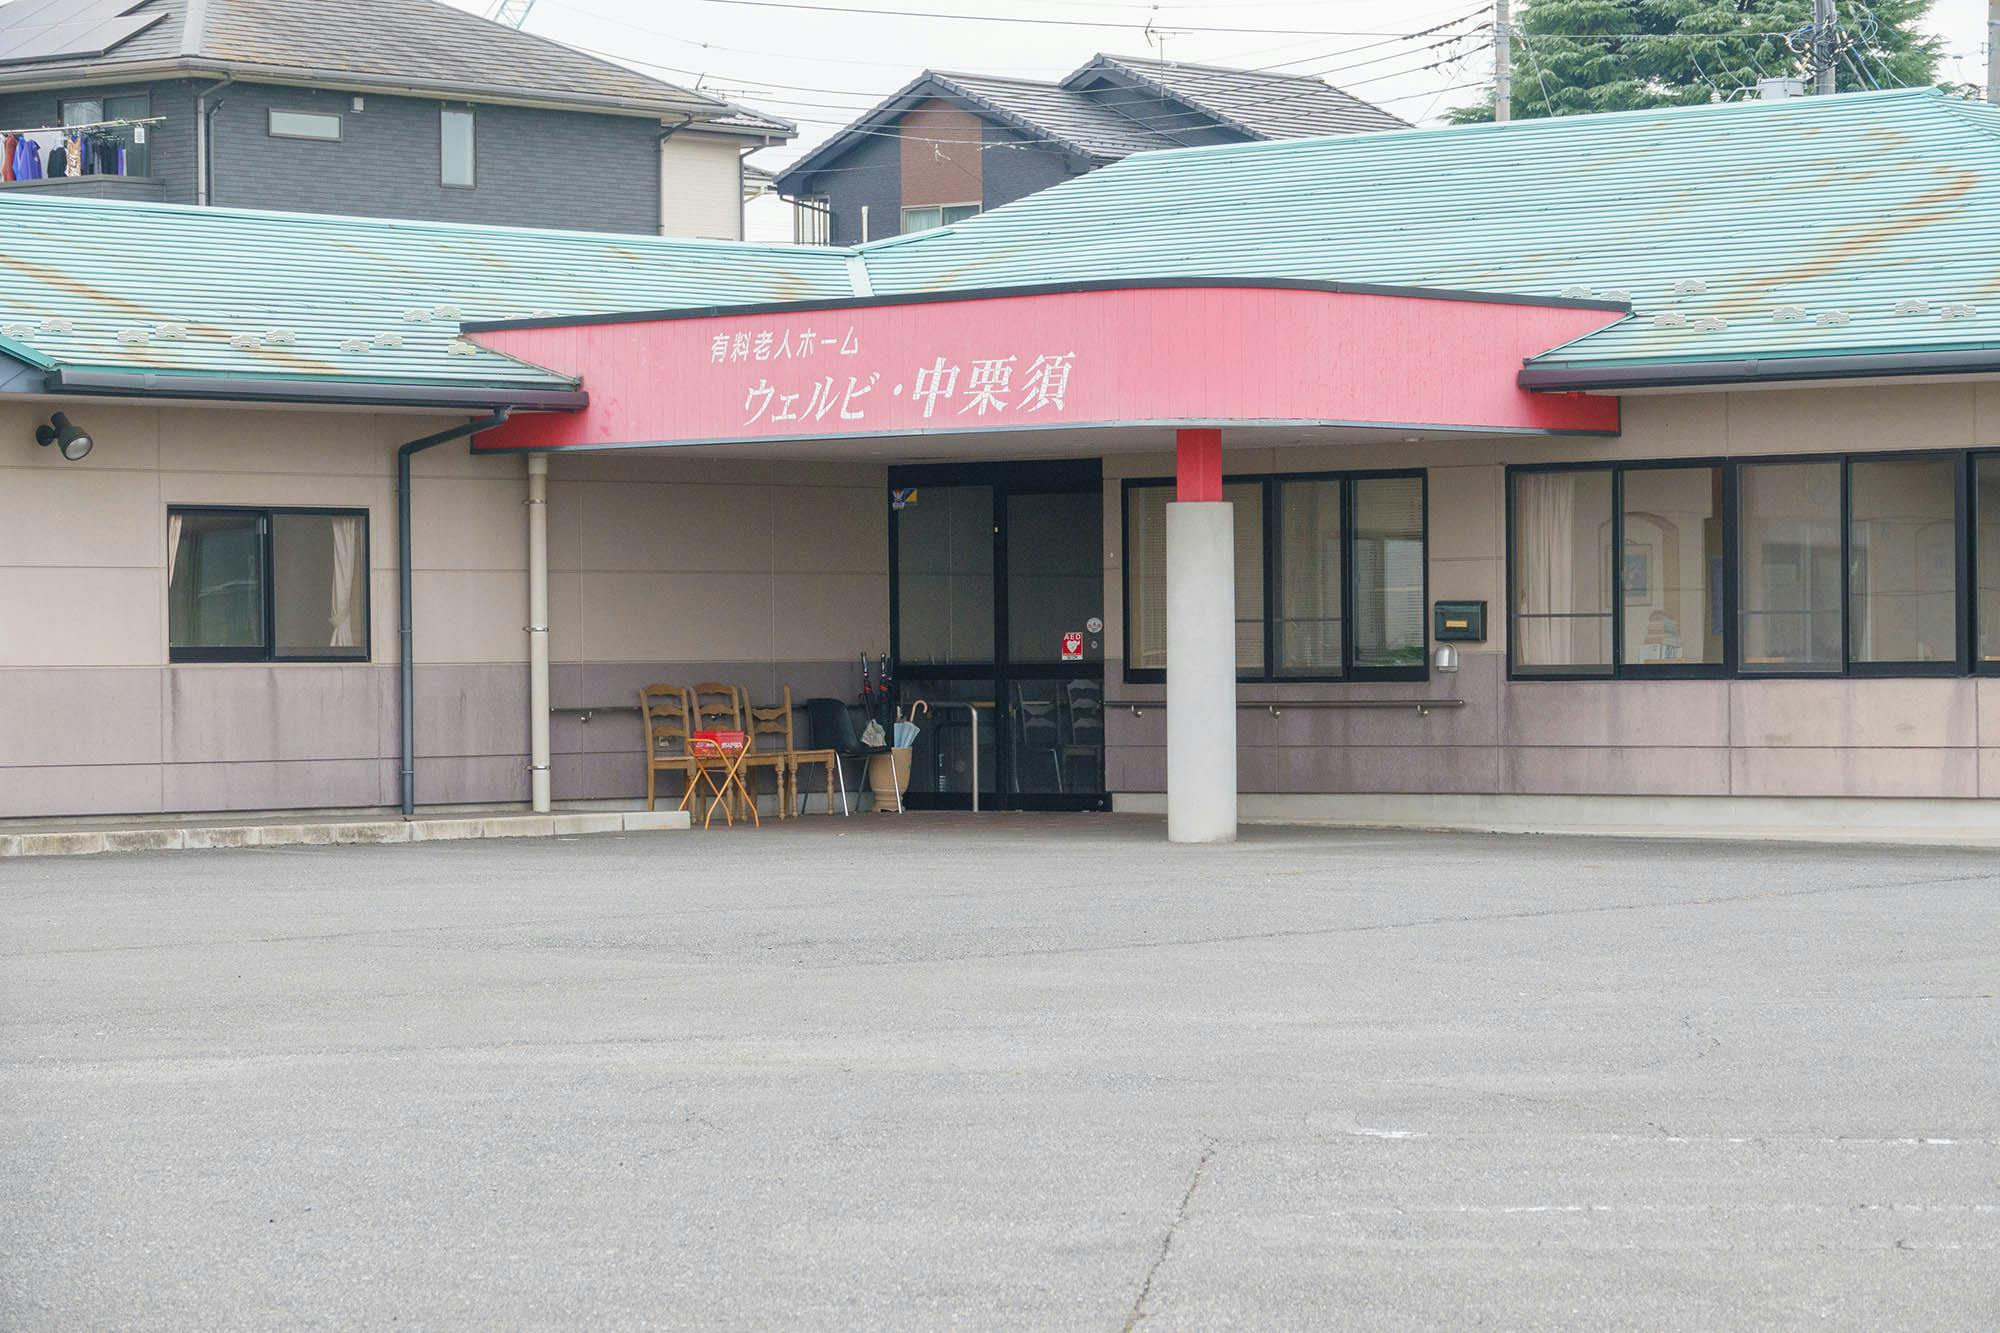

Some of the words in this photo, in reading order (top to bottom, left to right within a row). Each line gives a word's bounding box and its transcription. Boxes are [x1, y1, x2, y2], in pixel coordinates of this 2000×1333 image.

[711, 326, 859, 363] 有料老人ホーム
[743, 351, 1076, 426] ウェルビ・中栗須
[1063, 632, 1081, 640] AED
